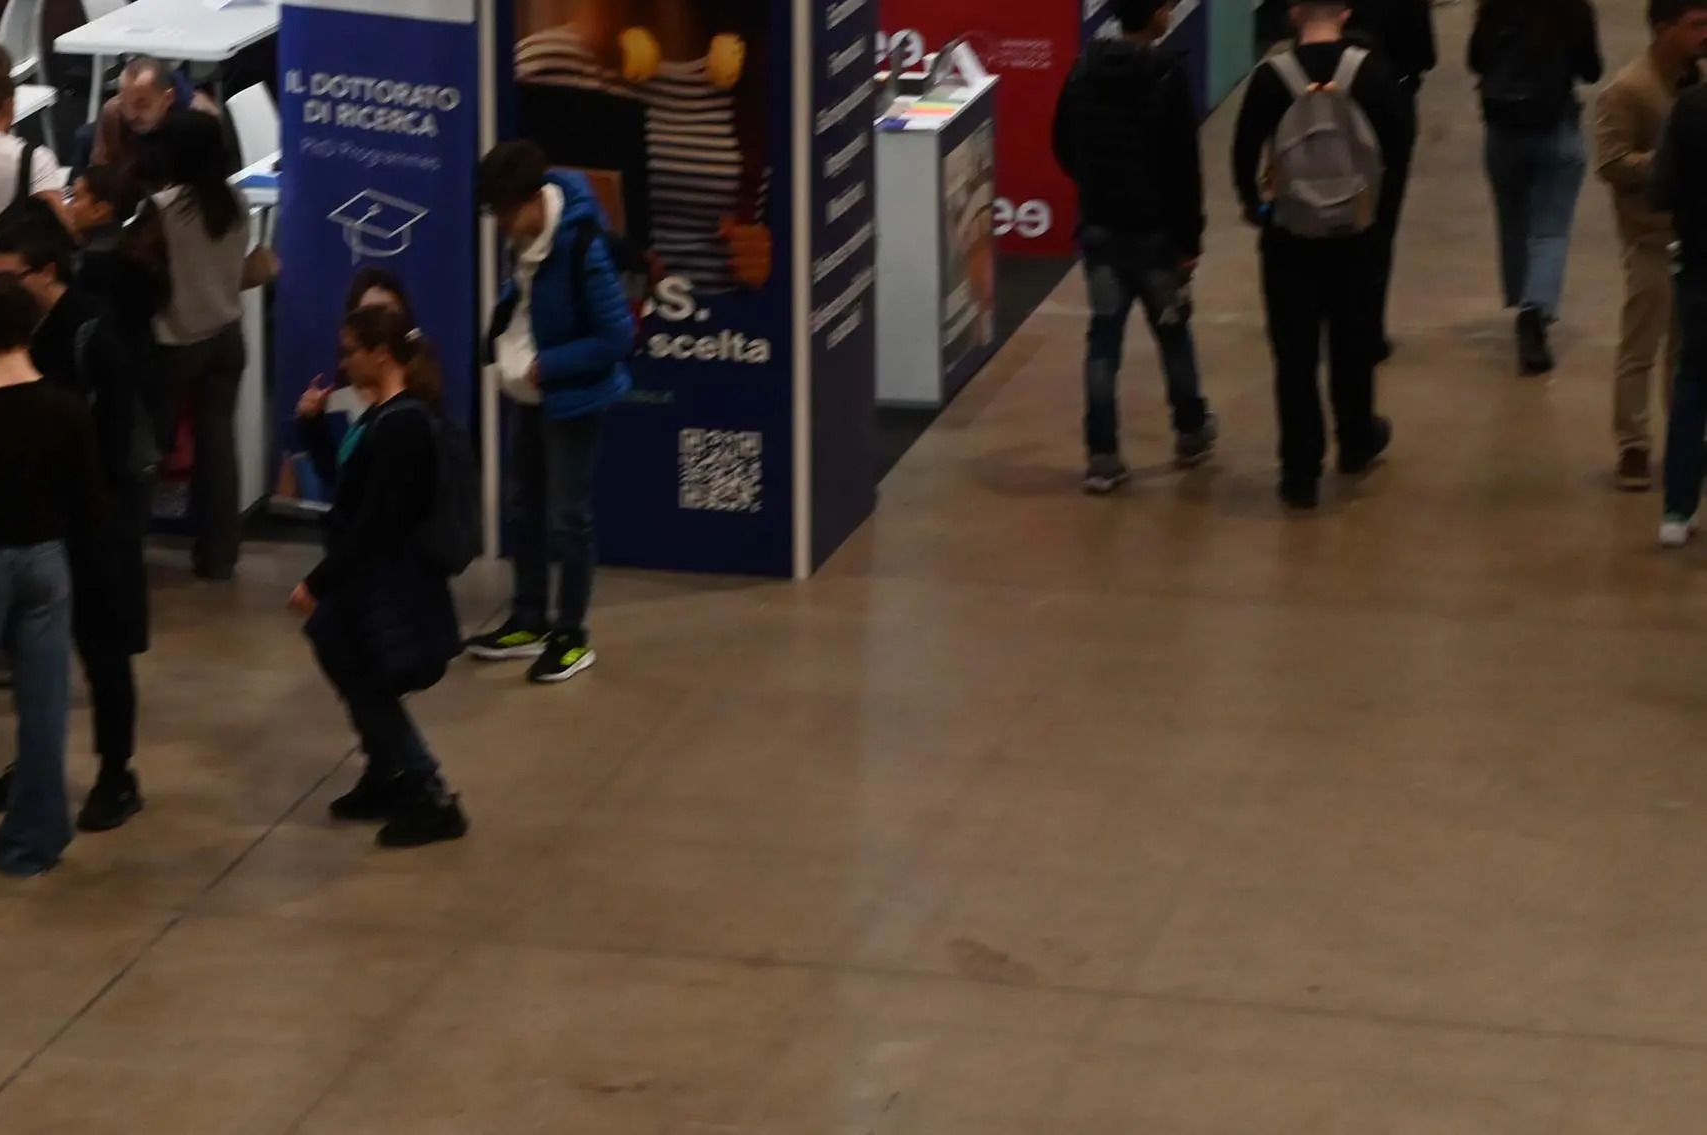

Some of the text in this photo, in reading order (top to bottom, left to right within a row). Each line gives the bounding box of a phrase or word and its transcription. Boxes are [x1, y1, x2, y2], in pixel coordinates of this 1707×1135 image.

[309, 72, 462, 112] DOTTORATO
[303, 98, 440, 138] DI RICERCA
[648, 328, 772, 363] scelta
